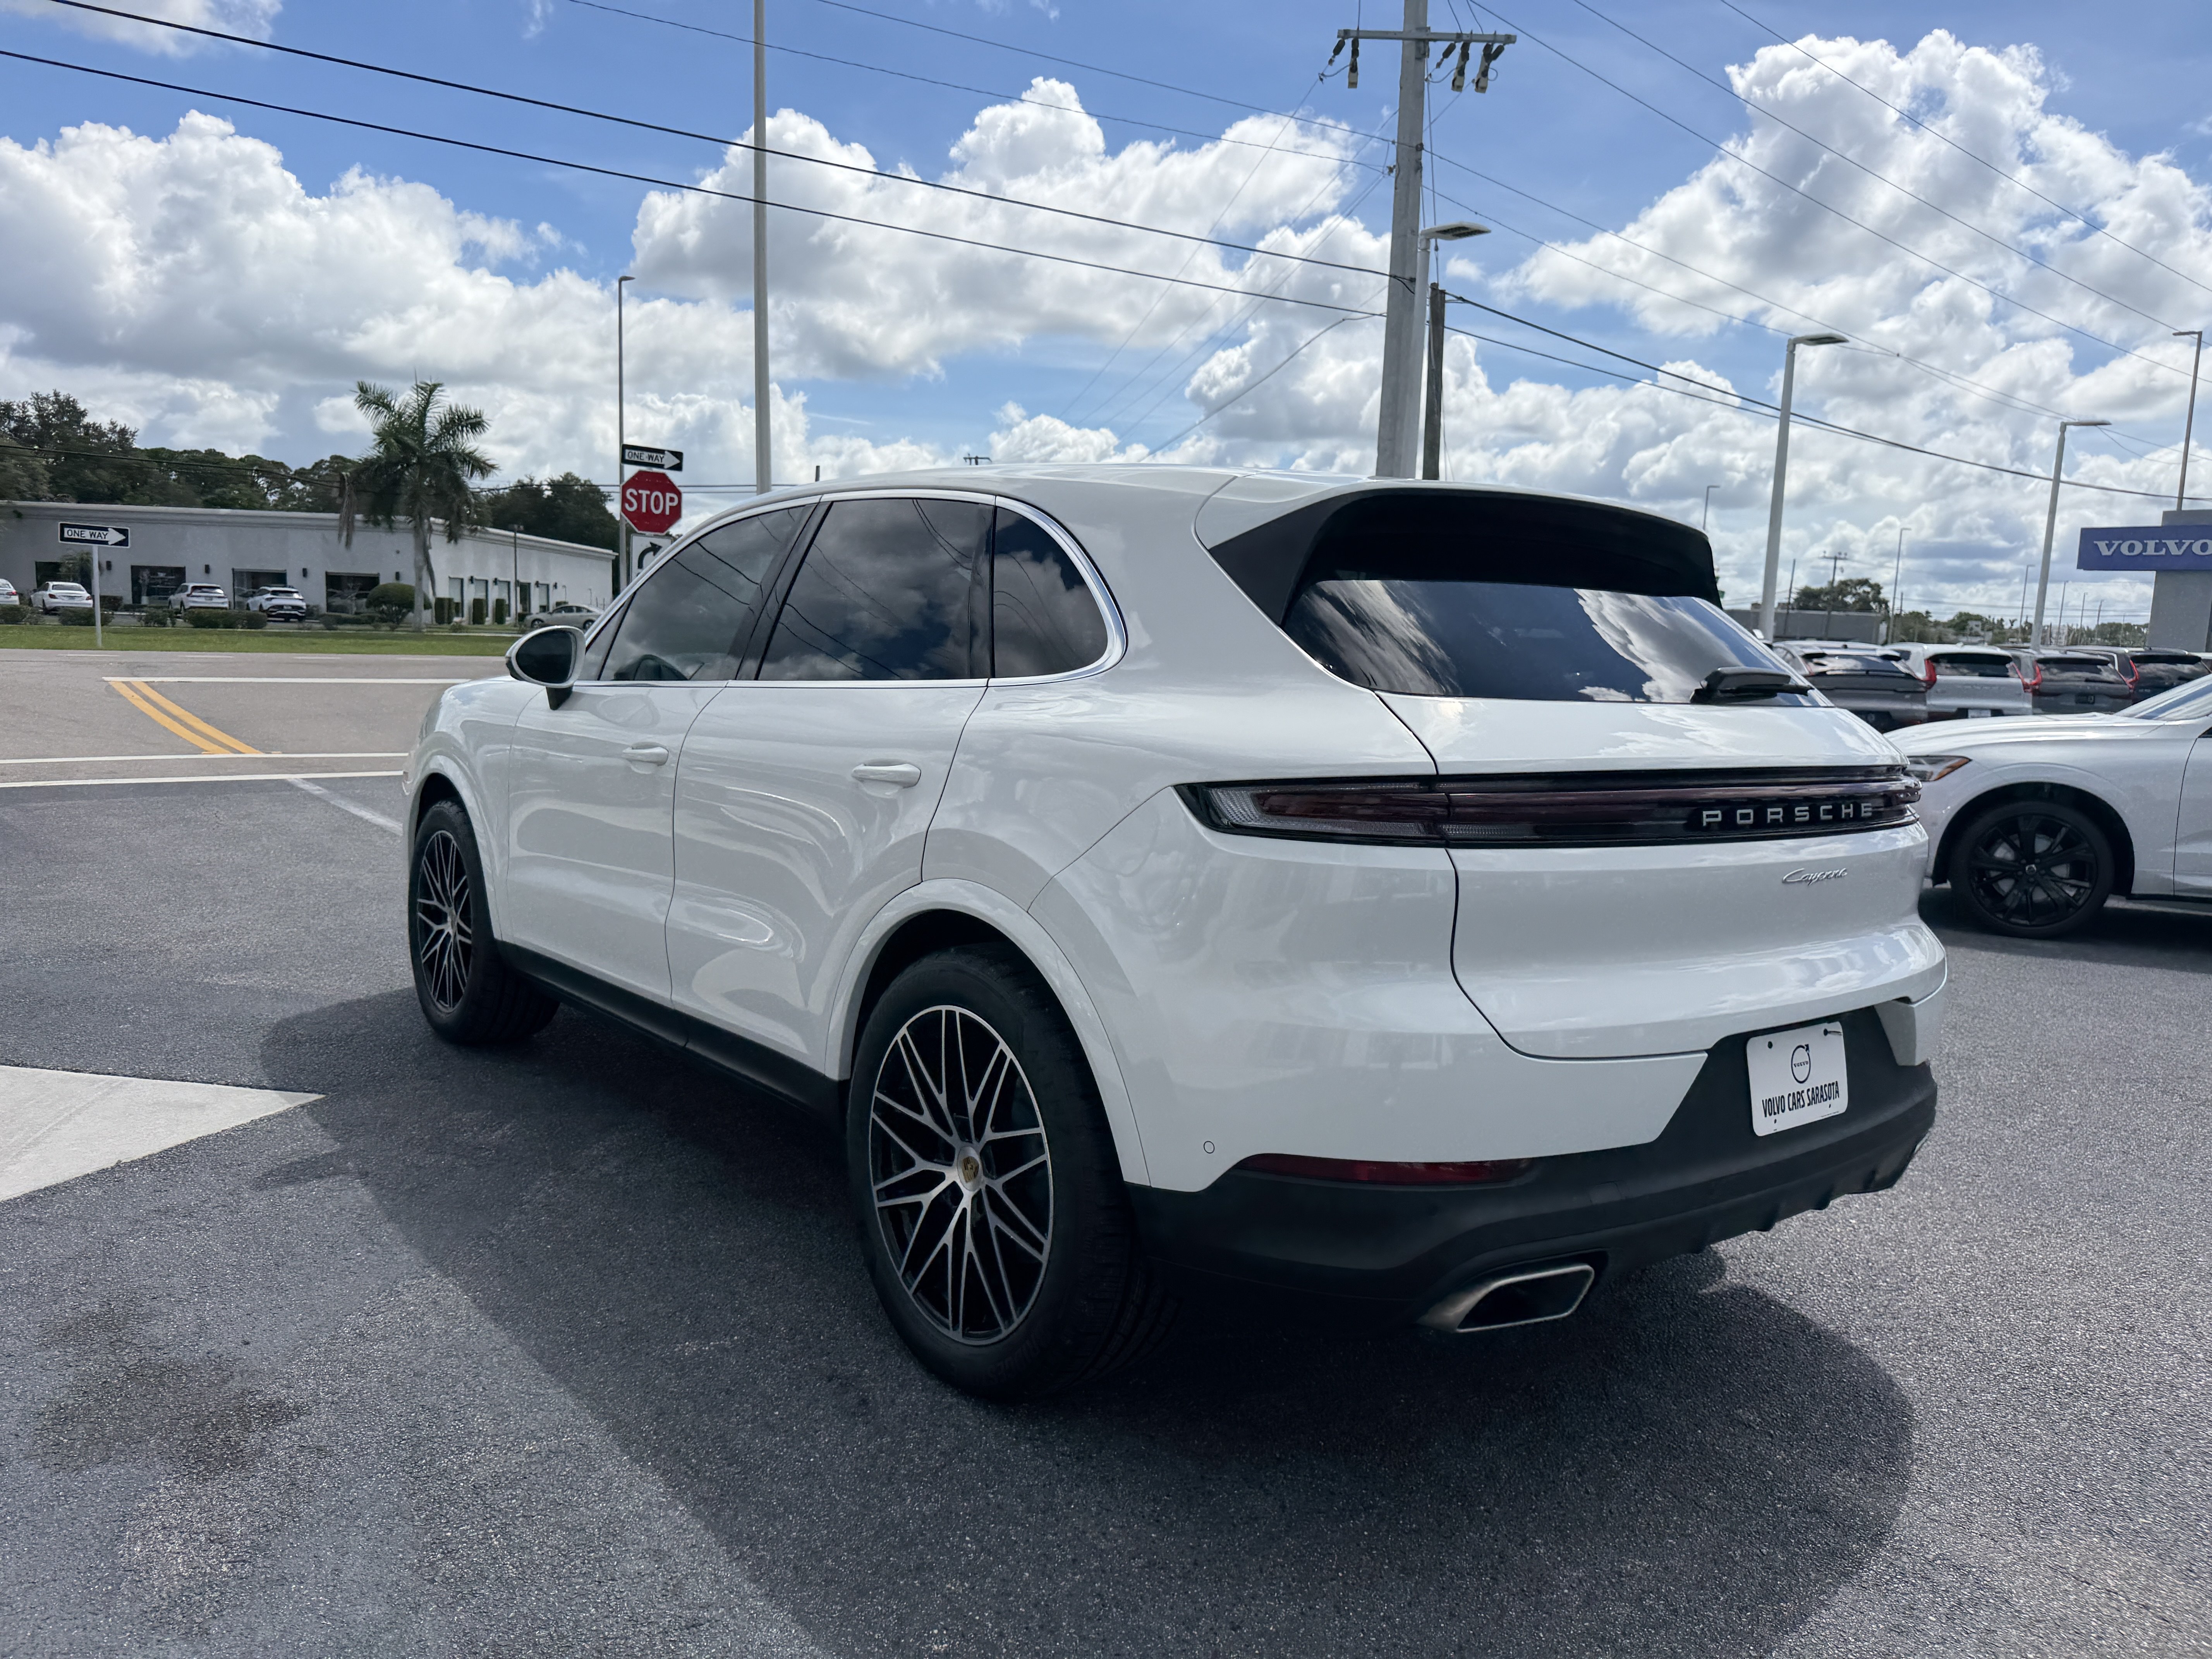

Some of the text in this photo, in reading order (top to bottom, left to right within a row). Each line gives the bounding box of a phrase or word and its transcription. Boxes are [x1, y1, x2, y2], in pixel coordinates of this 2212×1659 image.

[628, 451, 664, 463] ONE WAY
[625, 488, 678, 515] STOP
[67, 529, 108, 539] ONE WAY
[2094, 539, 2212, 556] VOLVO
[1702, 802, 1873, 826] PORSCHE
[1782, 867, 1848, 886] Cayenne
[1762, 1080, 1839, 1118] VOLVO CARS SARASOTA
